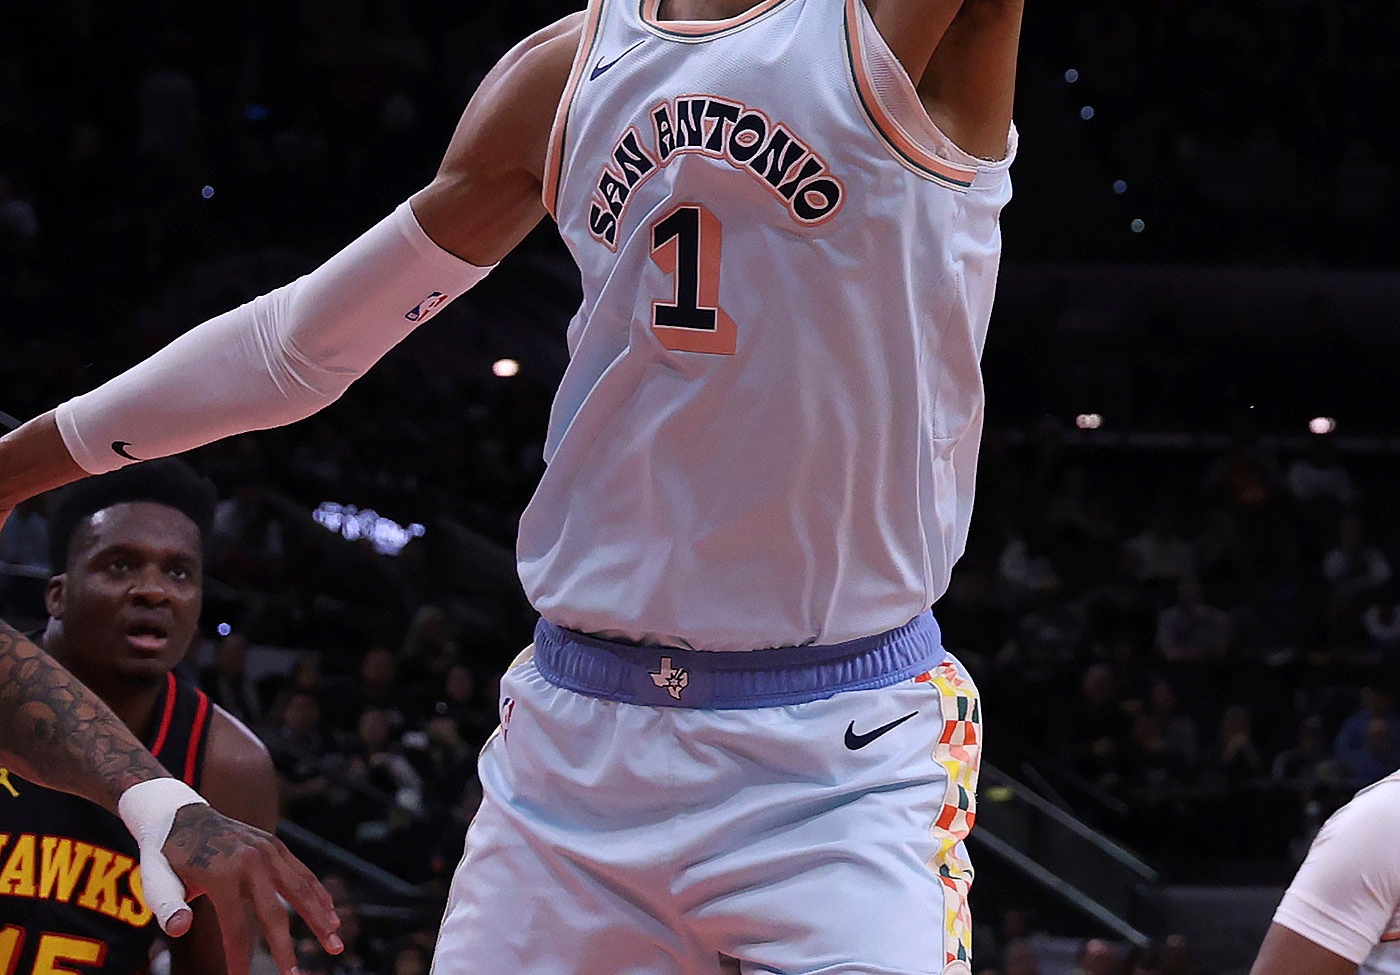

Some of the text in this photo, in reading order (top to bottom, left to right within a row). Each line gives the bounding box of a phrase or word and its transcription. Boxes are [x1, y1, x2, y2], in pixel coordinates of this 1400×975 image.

[587, 93, 847, 253] SAN ANTONIO
[651, 204, 733, 348] 1
[0, 831, 155, 928] AWKS
